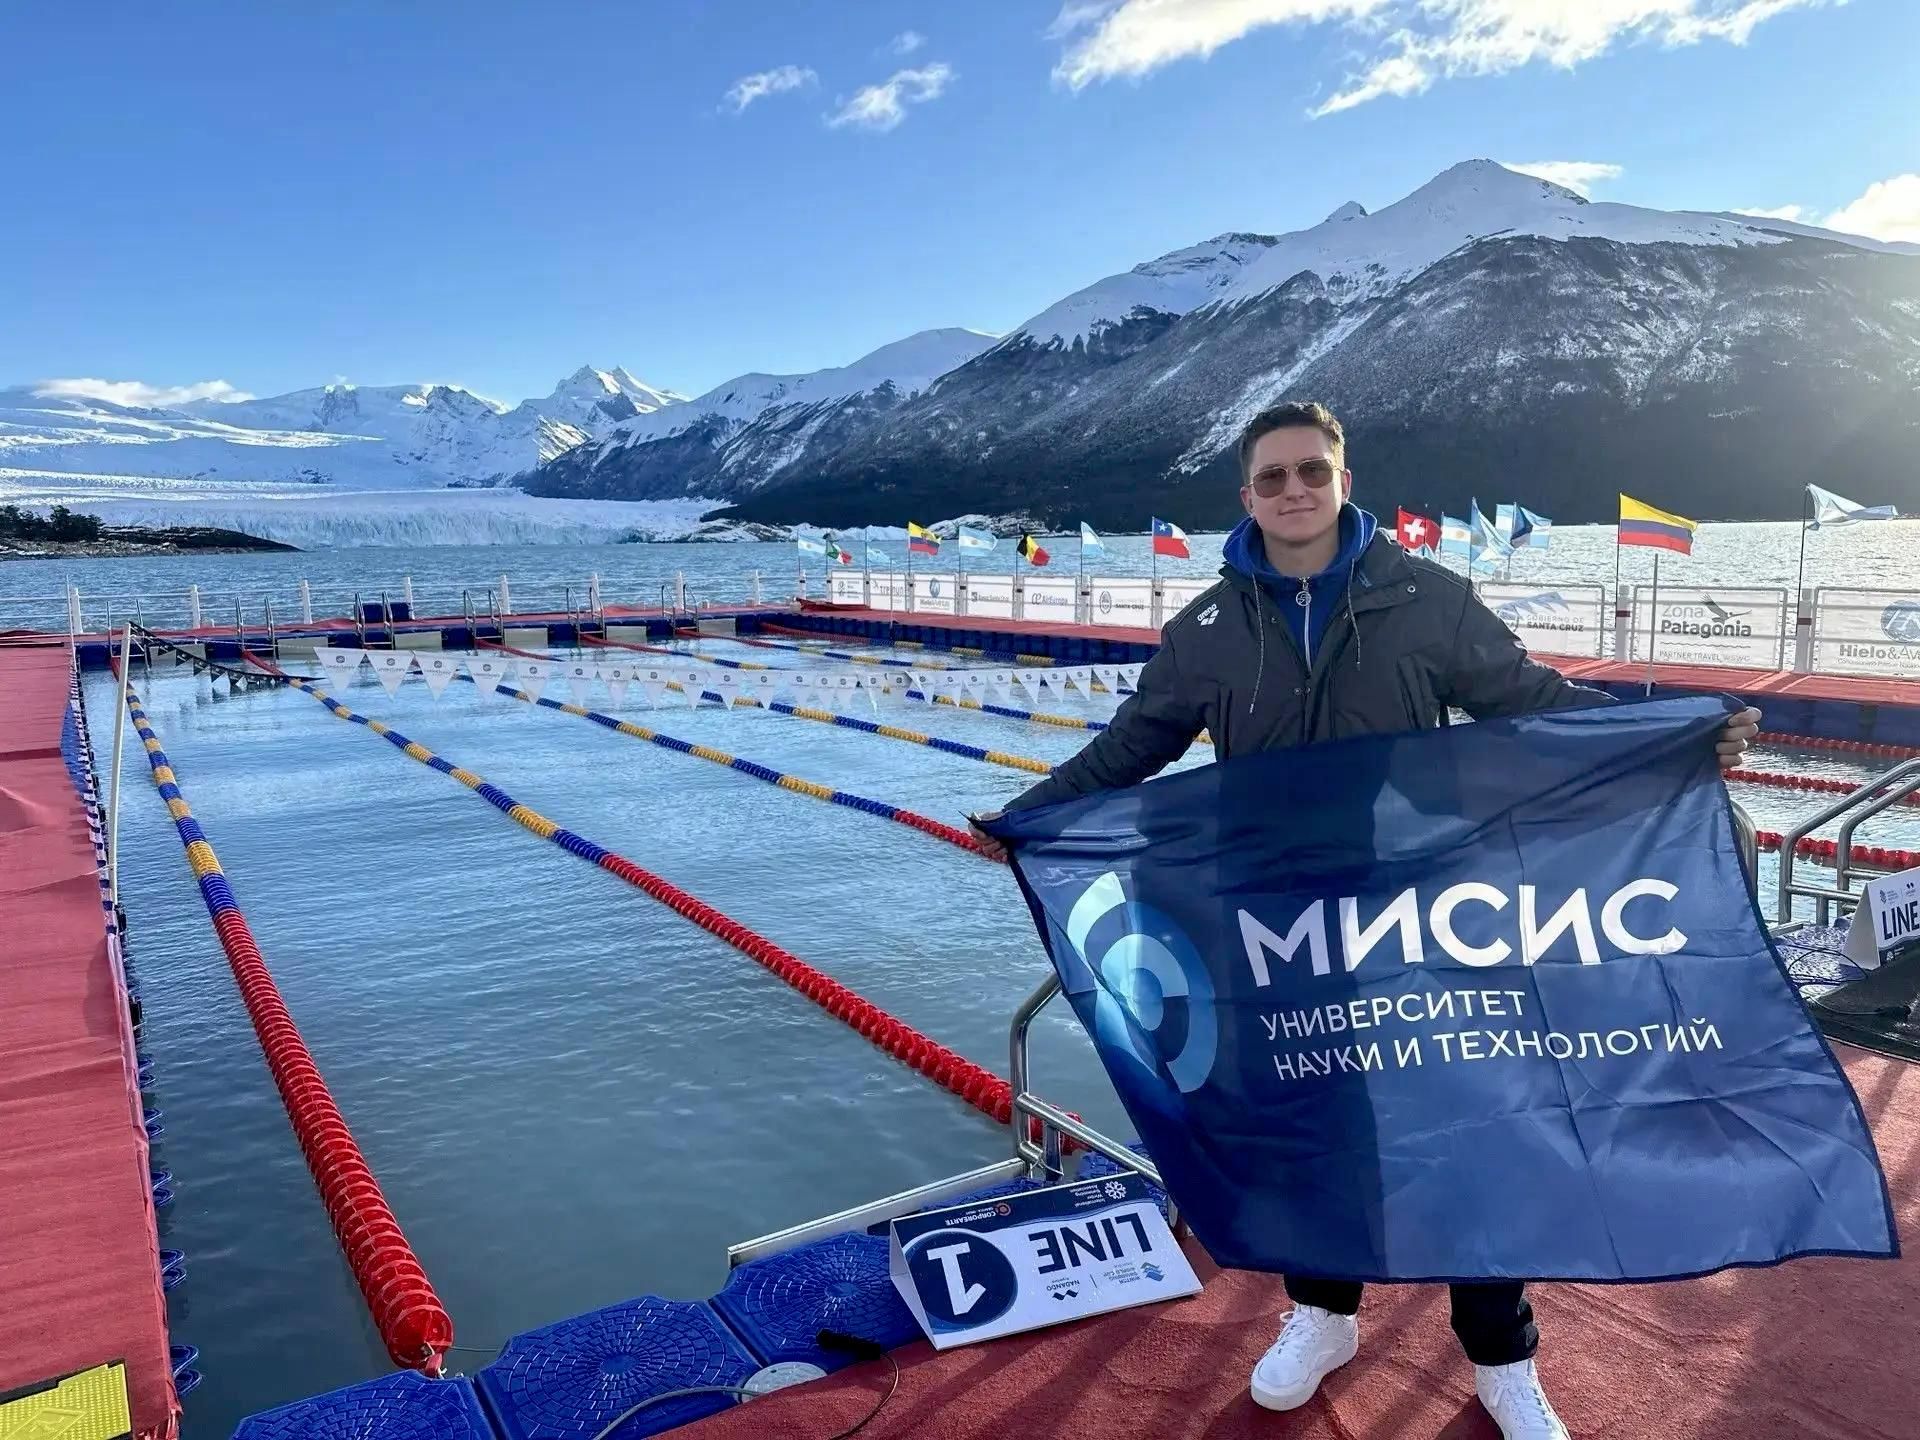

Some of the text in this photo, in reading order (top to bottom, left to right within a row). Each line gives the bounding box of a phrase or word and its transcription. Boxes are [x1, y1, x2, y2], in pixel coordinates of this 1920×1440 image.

[1197, 603, 1217, 621] arena
[1527, 614, 1584, 624] GOBIERNO DE
[1527, 621, 1584, 632] SANTA CRUZ
[1660, 619, 1752, 638] Patagonia
[1659, 650, 1694, 659] PARTNER
[1694, 651, 1720, 661] TRAVEL
[1882, 901, 1920, 940] LINE
[1238, 878, 1689, 987] МИСИС
[1259, 990, 1526, 1041] УНИВЕРСИТЕТ
[1273, 1017, 1723, 1081] НАУКИ И ТЕХНОЛОГИЙ
[945, 1211, 996, 1226] CORPOREARTE
[1028, 1212, 1153, 1274] LINE
[927, 1241, 986, 1316] 1
[1046, 1279, 1081, 1292] NADANDO
